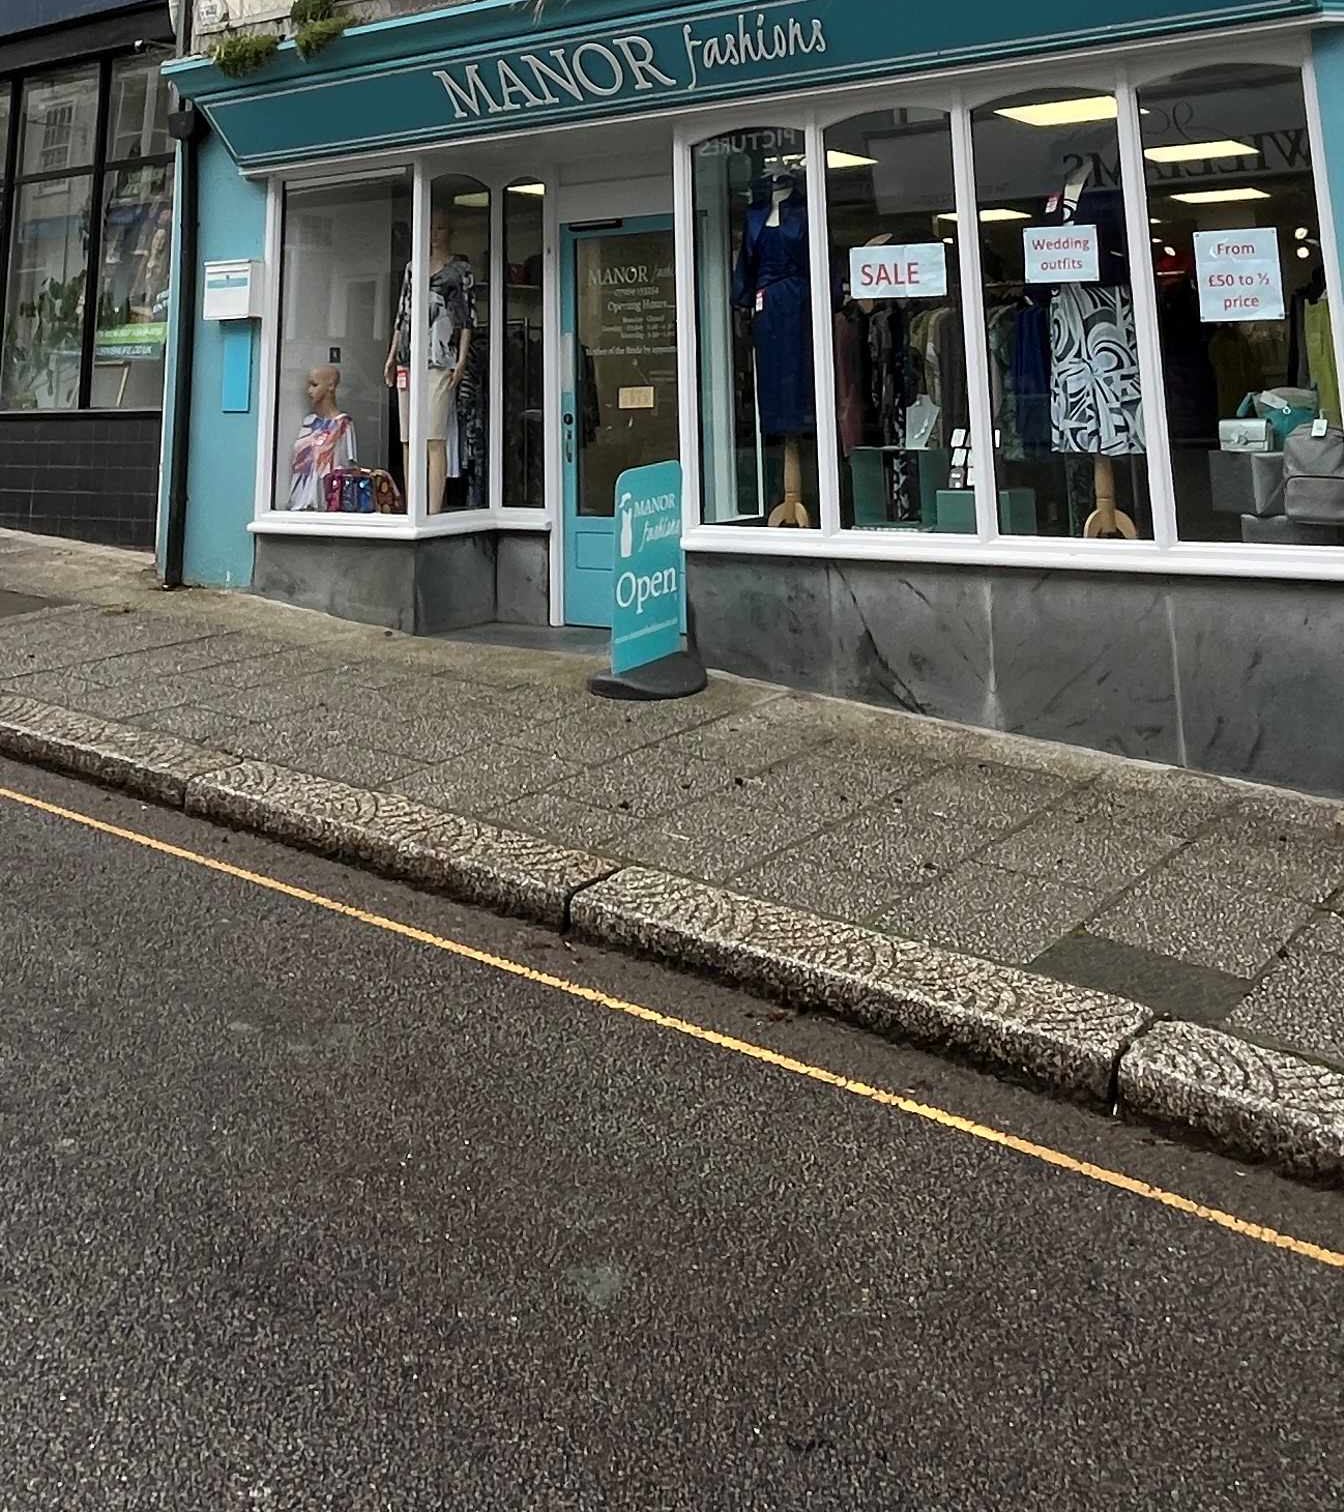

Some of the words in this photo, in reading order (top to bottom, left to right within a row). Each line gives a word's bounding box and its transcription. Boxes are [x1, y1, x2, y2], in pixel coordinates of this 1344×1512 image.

[433, 35, 676, 118] MANOR
[681, 13, 827, 89] fashions
[1032, 238, 1089, 252] Wedding
[1217, 243, 1255, 255] From
[1040, 257, 1083, 271] outfits
[588, 266, 648, 287] MANOR
[861, 263, 920, 286] SALE
[1208, 274, 1235, 287] £50
[1238, 274, 1253, 286] to
[1224, 295, 1259, 311] price
[633, 493, 676, 517] MANOR
[616, 566, 677, 615] Open
